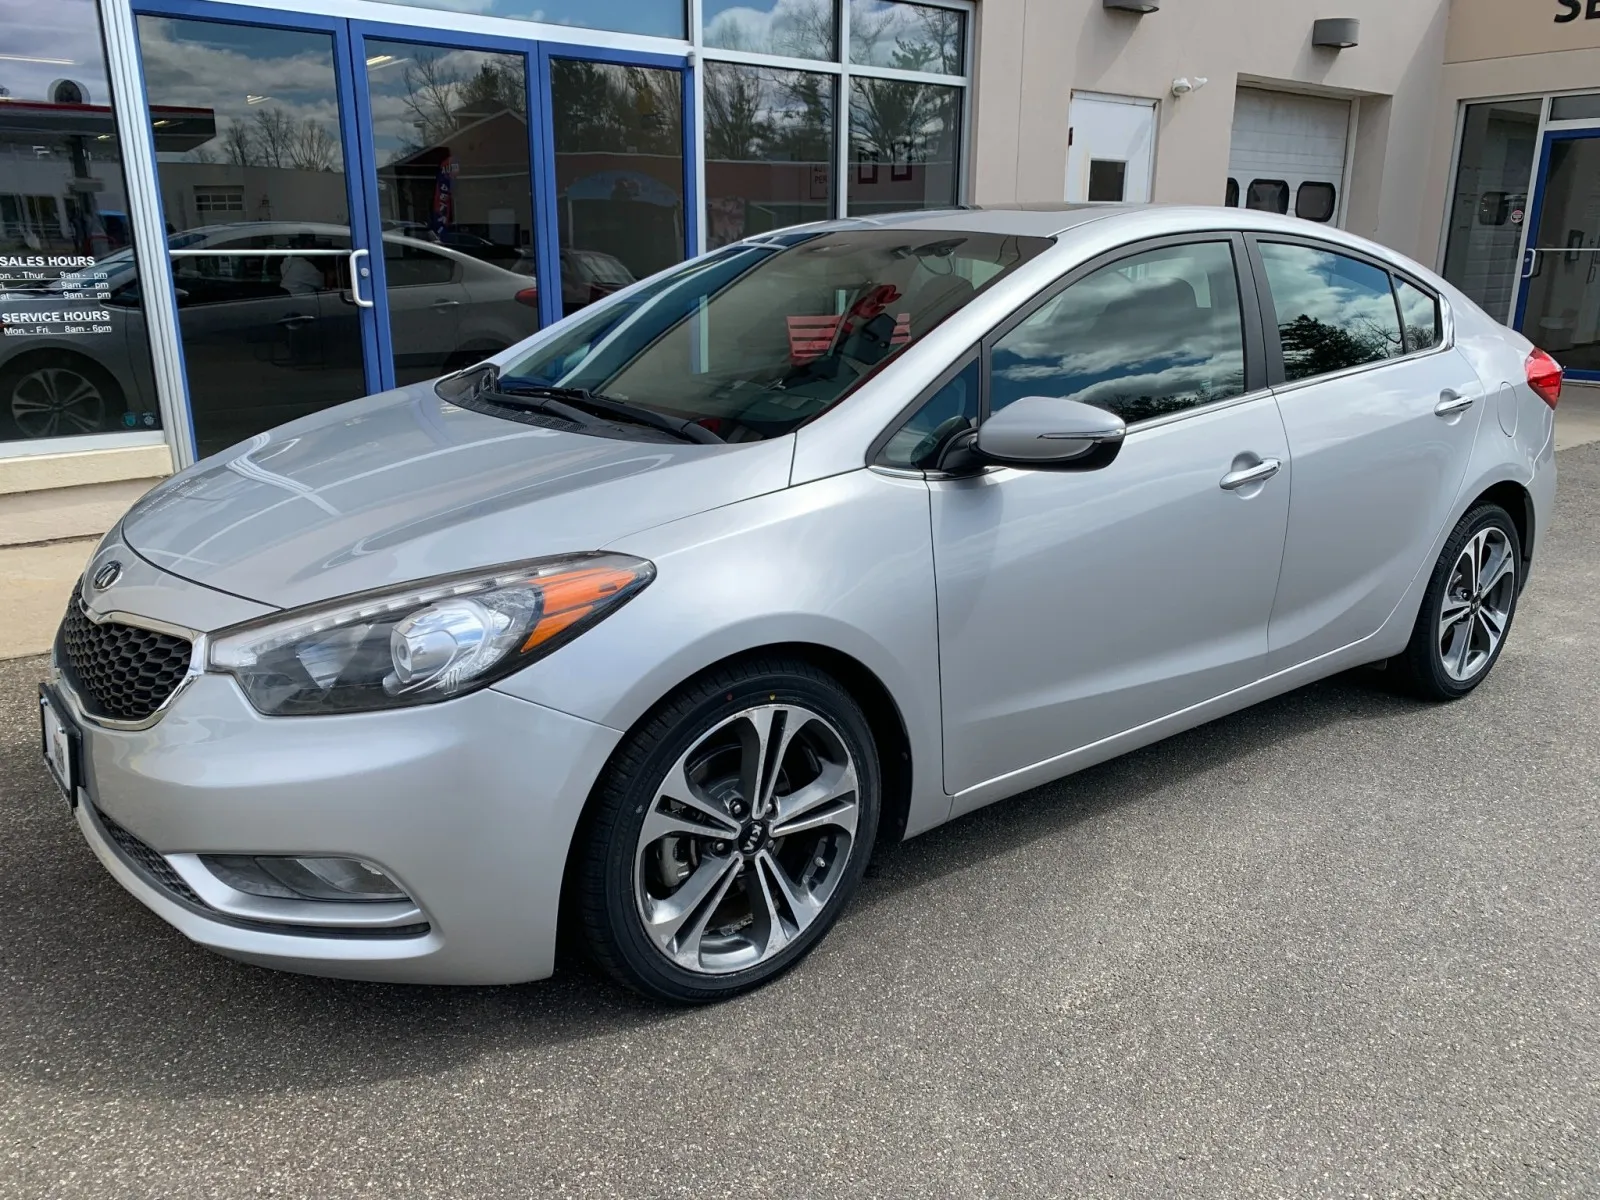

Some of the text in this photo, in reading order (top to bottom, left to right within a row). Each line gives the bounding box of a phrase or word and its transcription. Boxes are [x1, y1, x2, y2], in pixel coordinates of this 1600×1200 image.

[0, 256, 95, 266] SALES HOURS
[0, 272, 14, 280] on.
[22, 271, 46, 279] Thur.
[60, 271, 80, 279] 9am
[93, 272, 108, 280] pm
[61, 281, 81, 289] 9am
[63, 291, 83, 299] 9am
[2, 310, 110, 323] SERVICE HOURS
[4, 327, 28, 336] Mon.
[36, 326, 52, 334] Fri.
[64, 325, 85, 333] 8am
[92, 324, 112, 333] 6pm
[743, 824, 762, 850] KIA
